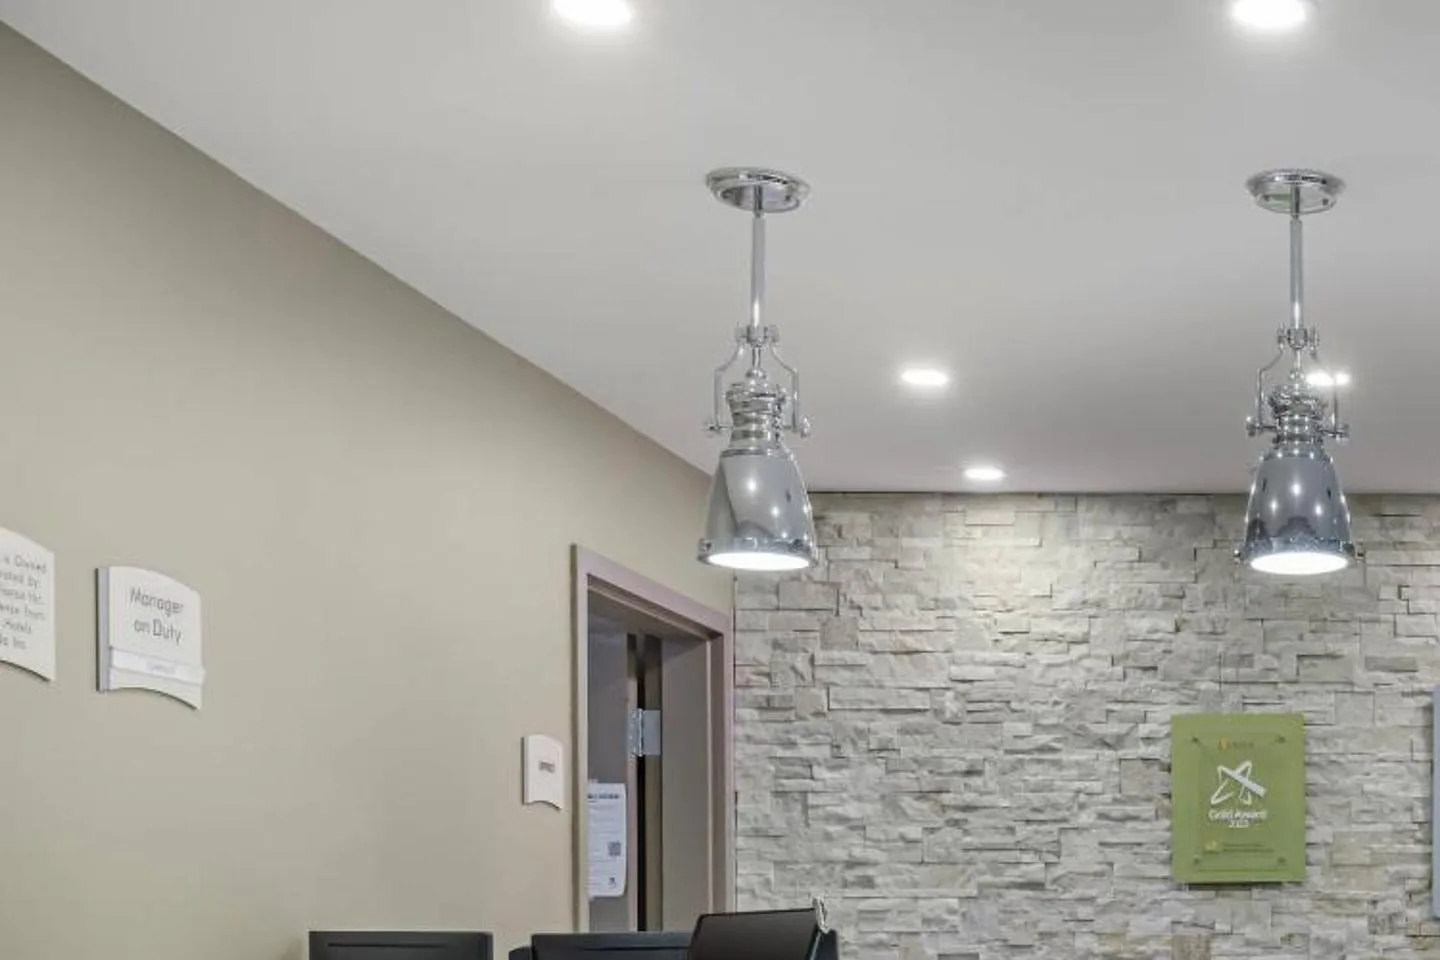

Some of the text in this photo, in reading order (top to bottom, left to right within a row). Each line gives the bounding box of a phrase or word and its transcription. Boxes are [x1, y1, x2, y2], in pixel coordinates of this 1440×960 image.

[130, 586, 184, 617] Manager
[133, 618, 182, 646] on Duty
